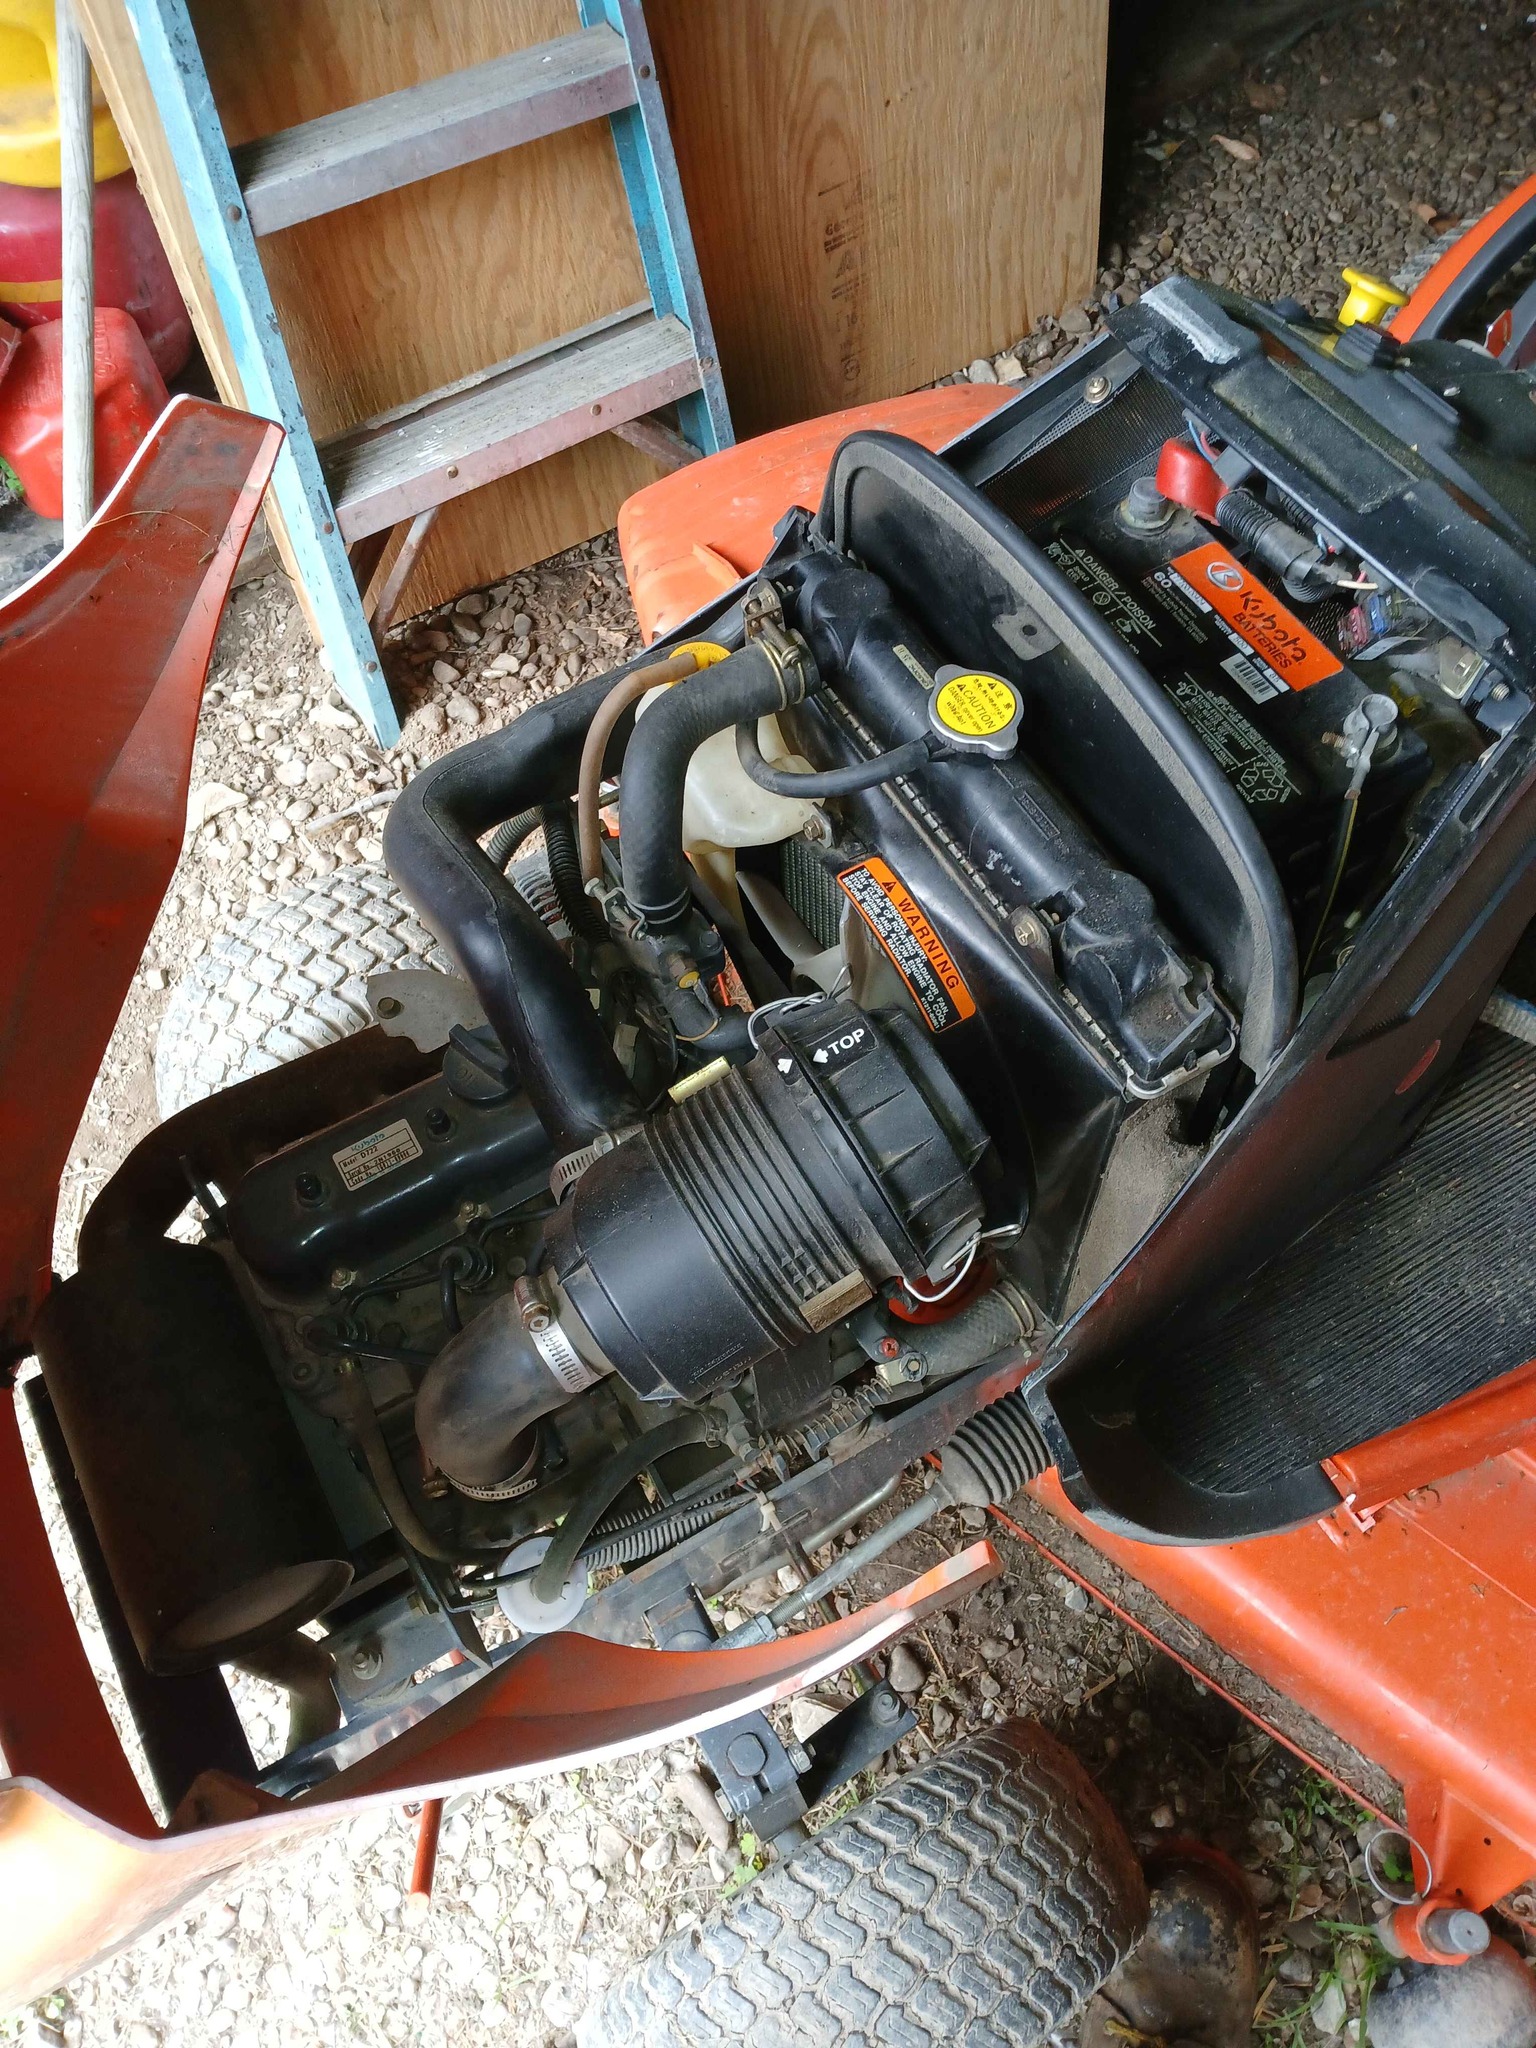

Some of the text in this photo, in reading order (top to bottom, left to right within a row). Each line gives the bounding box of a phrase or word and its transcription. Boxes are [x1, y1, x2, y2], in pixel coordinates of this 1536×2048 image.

[1083, 555, 1119, 591] DANGER
[1121, 595, 1156, 629] POISON
[1240, 590, 1308, 663] Kubota
[1232, 612, 1293, 669] BATTERIES
[963, 688, 996, 729] CAUTION
[1214, 731, 1228, 744] FAST
[842, 877, 912, 978] BEFORE SERVICING RADIATOR.
[848, 874, 947, 1026] STOP ENGINE AND ALLOW ENGINE TO COOL
[854, 871, 869, 885] STAY
[866, 886, 885, 908] CLEAR
[882, 909, 893, 919] OF
[891, 921, 916, 956] ROTATING
[914, 957, 939, 995] RADIATOR
[861, 867, 928, 963] TO AVOID PERSONAL INJURY:
[899, 898, 961, 990] WARNING
[827, 1028, 865, 1055] TOP
[351, 1133, 385, 1152] Kubota
[360, 1146, 378, 1159] D722
